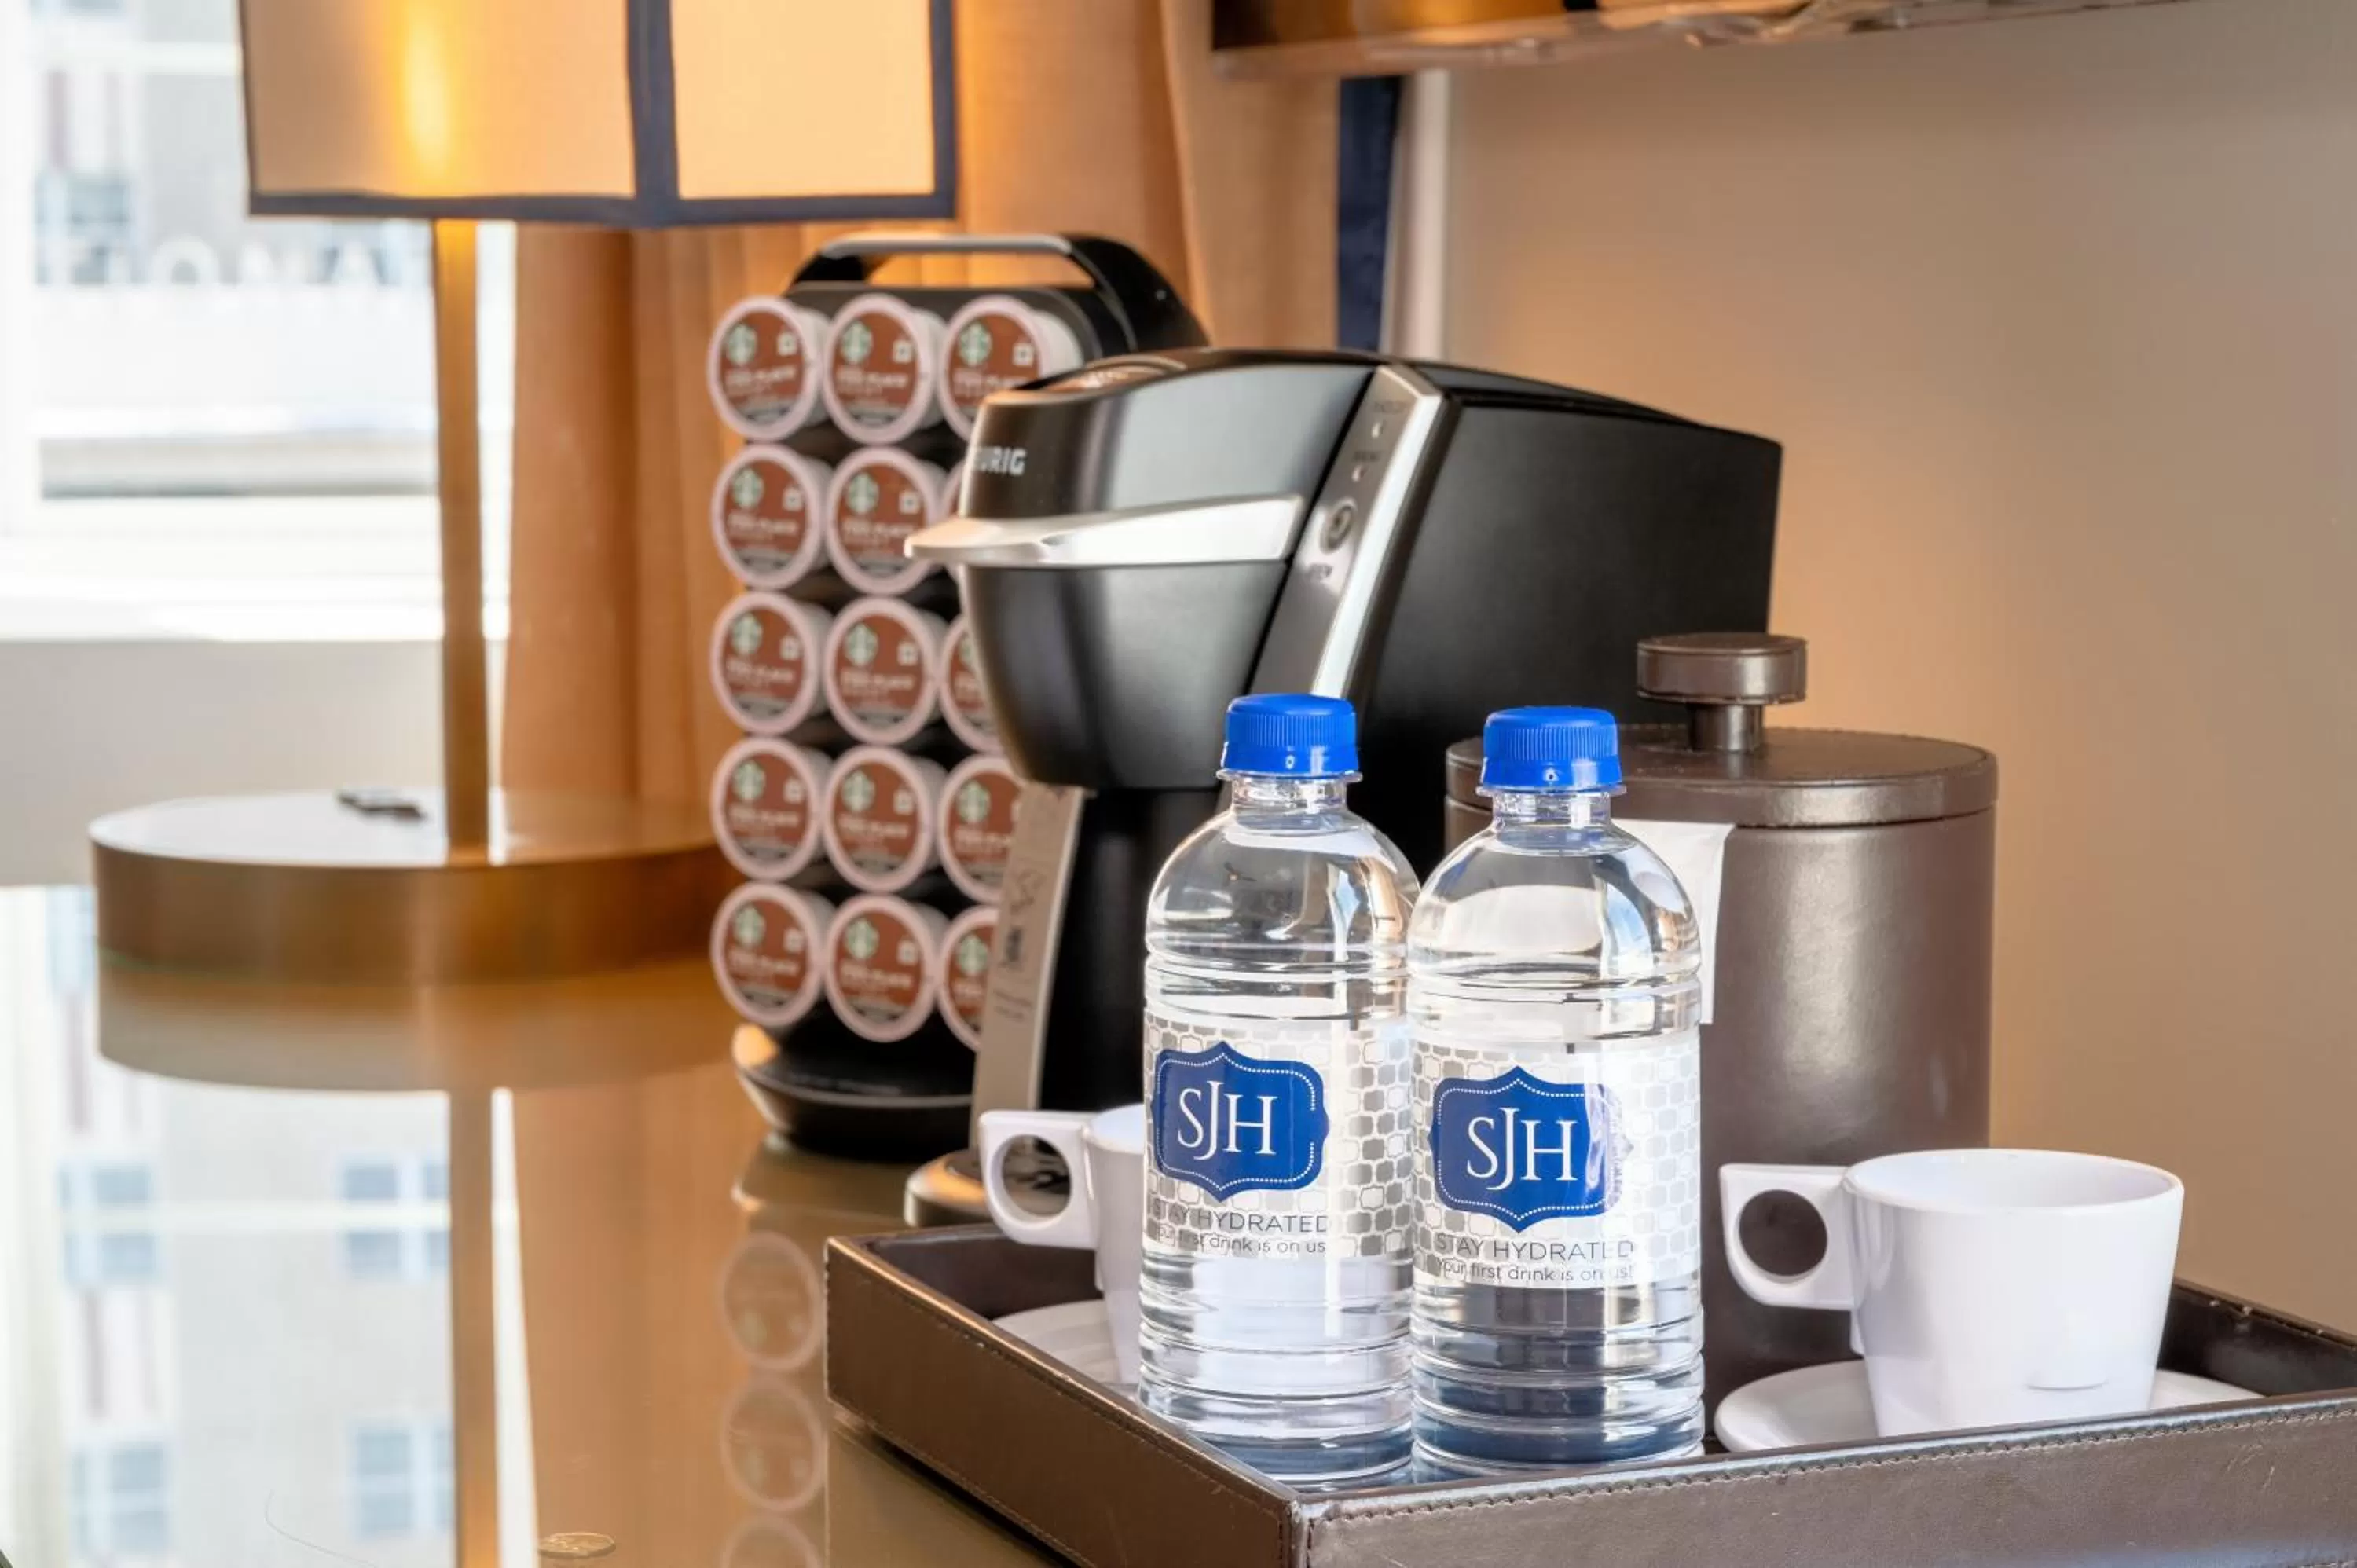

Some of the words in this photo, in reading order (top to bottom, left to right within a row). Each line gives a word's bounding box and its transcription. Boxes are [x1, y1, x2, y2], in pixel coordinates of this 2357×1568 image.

[1177, 1080, 1277, 1160] SJH
[1466, 1106, 1578, 1190] SJH
[1198, 1208, 1329, 1233] HYDRATED
[1210, 1234, 1252, 1252] drink
[1258, 1238, 1270, 1253] is
[1277, 1241, 1300, 1253] on
[1494, 1240, 1635, 1260] HYDRATED
[1471, 1262, 1501, 1279] first
[1508, 1265, 1555, 1281] drink
[1561, 1266, 1573, 1281] is
[1580, 1268, 1604, 1282] on
